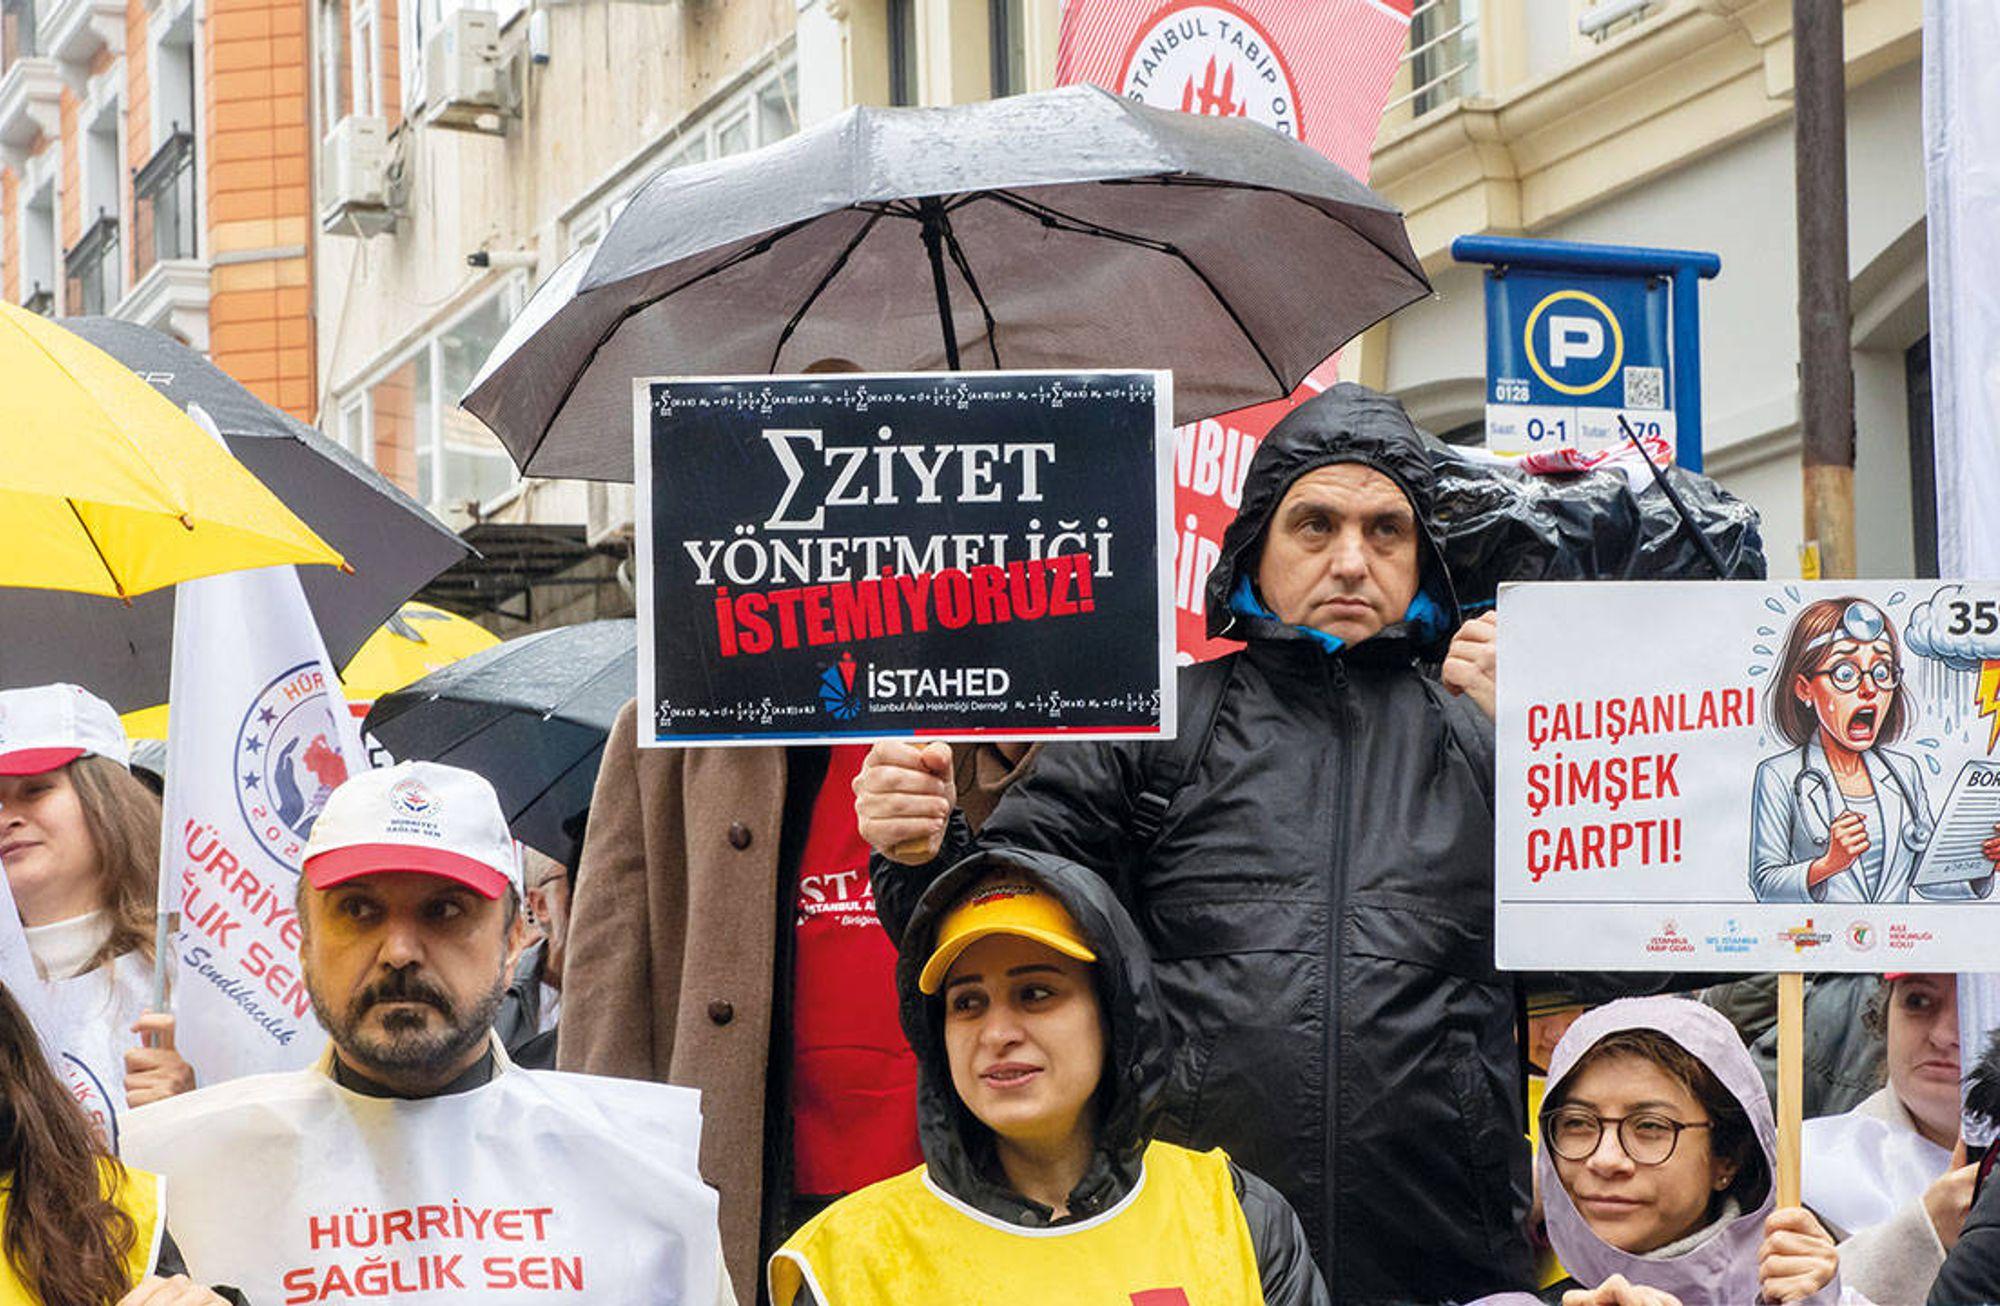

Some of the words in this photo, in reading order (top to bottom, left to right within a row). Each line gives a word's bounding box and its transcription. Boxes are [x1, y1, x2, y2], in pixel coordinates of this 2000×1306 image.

[1128, 17, 1208, 104] STANBUL
[1219, 19, 1277, 84] TABİP
[1549, 316, 1604, 367] P
[1495, 384, 1530, 402] 0128
[1527, 419, 1566, 442] 0-1
[715, 552, 1096, 658] İSTEMİYORUZ!
[1948, 601, 2000, 636] 35
[866, 662, 1010, 698] İSTAHED
[1526, 686, 1756, 751] ÇALIŞANLARI
[1526, 753, 1681, 817] ŞİMŞEK
[1966, 770, 2000, 787] BOR
[1526, 818, 1683, 882] ÇARPTI!
[184, 818, 304, 952] ÜRRİYE
[240, 940, 313, 1019] SEN
[309, 1197, 554, 1250] HÜRRİYET
[282, 1253, 464, 1305] SAĞLIK
[484, 1256, 584, 1292] SEN
